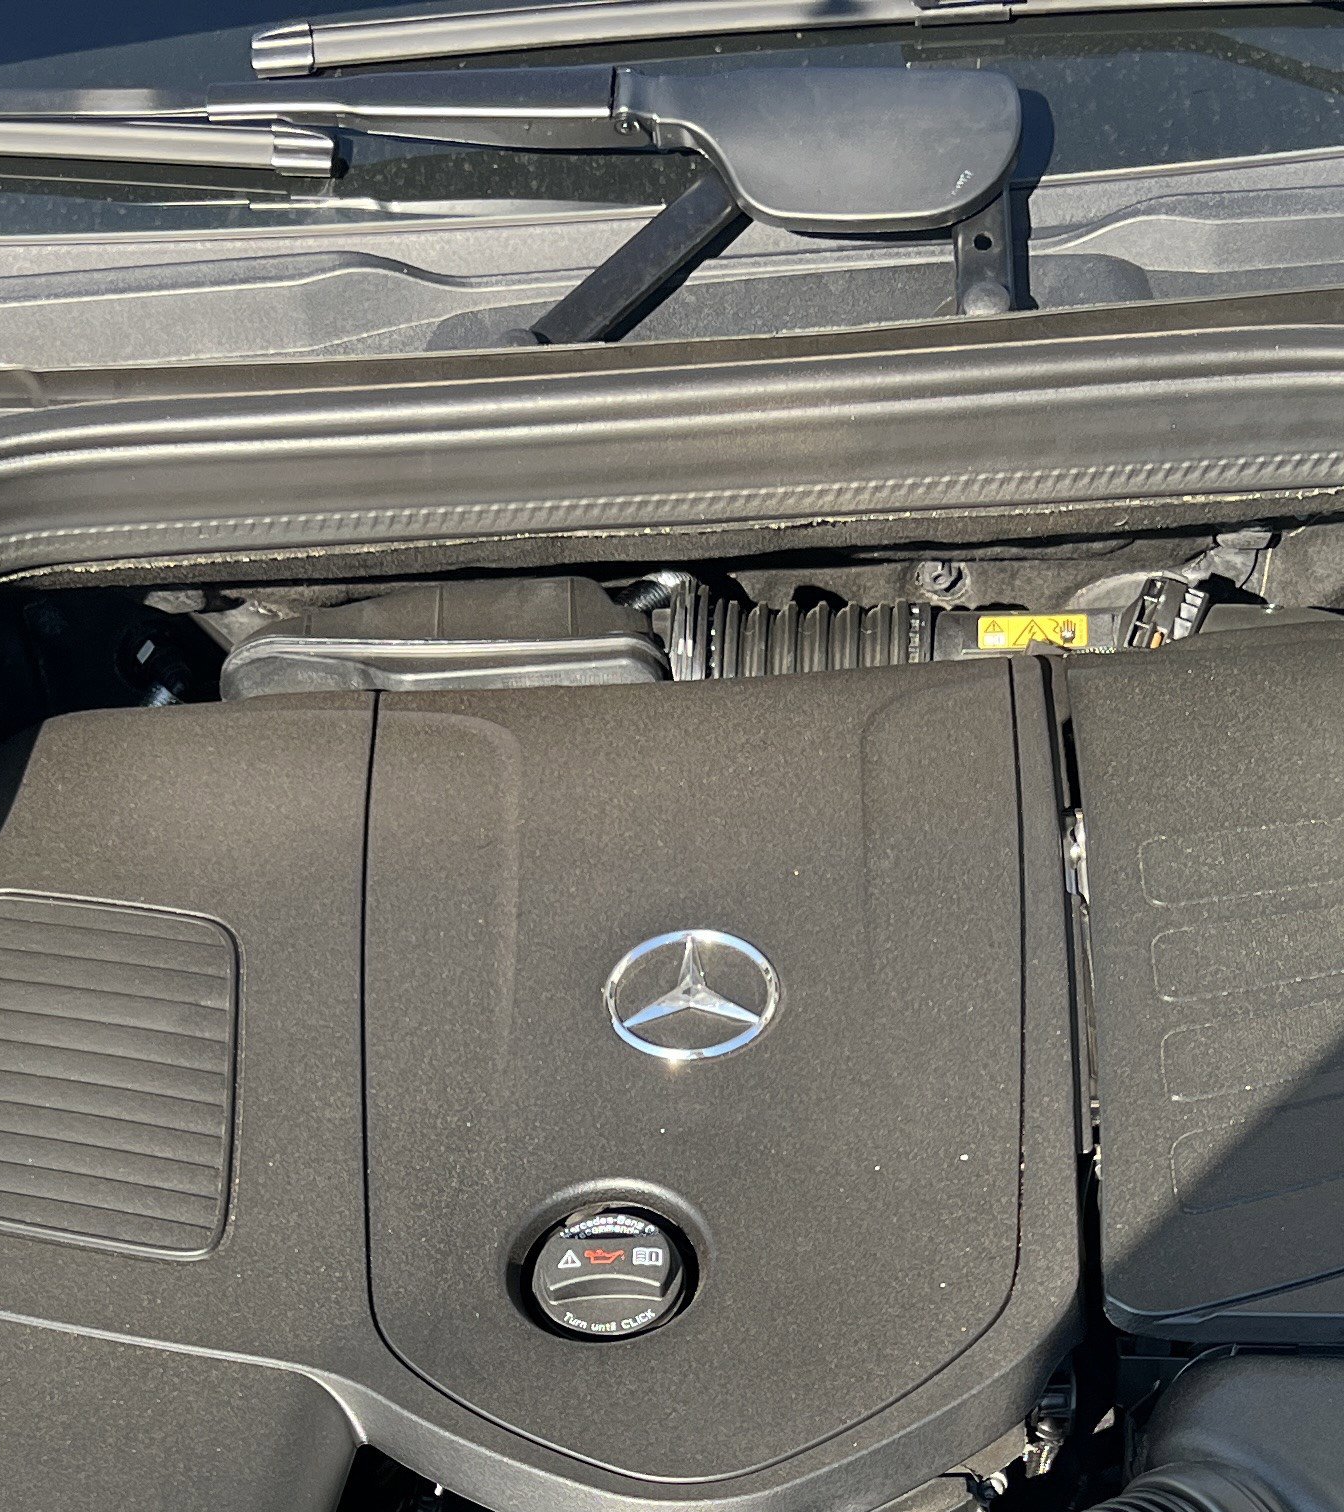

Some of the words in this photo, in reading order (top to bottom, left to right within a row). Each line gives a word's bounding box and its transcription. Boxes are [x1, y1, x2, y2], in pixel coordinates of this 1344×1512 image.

[563, 1312, 587, 1330] Turn
[591, 1321, 617, 1331] until
[620, 1309, 656, 1329] CLICK
